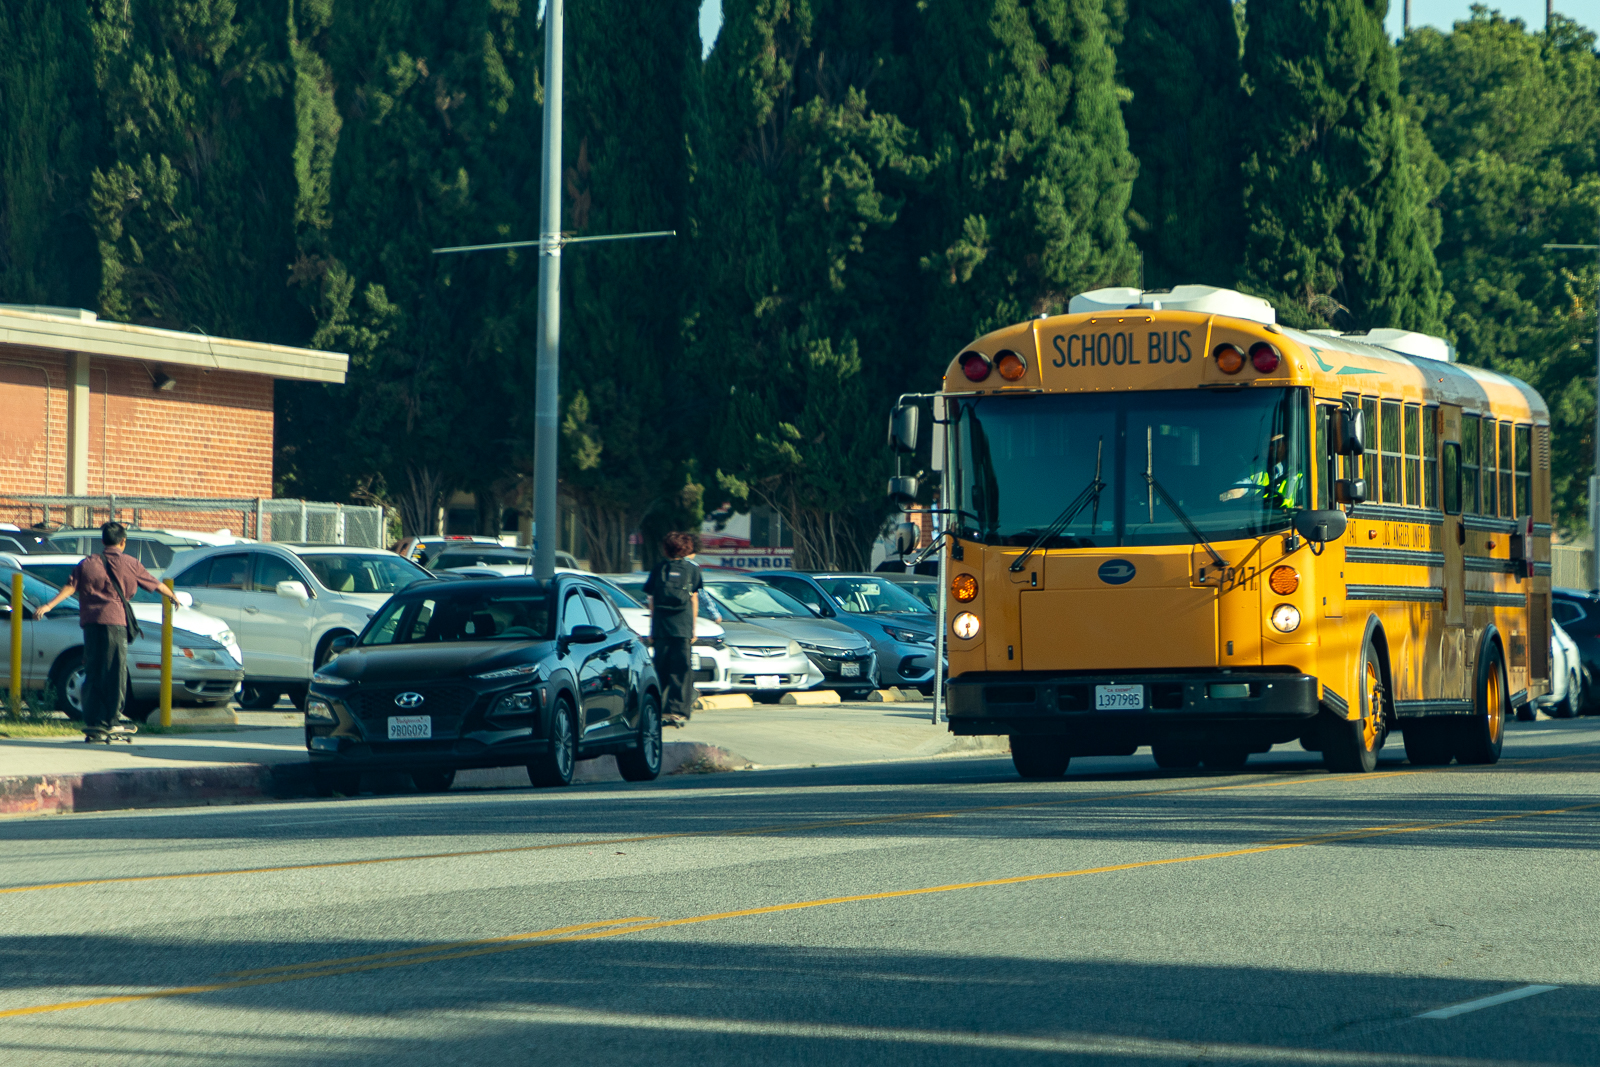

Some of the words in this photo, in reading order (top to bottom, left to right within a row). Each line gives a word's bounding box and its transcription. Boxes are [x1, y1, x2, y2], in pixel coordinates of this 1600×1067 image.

[1052, 331, 1140, 368] SCHOOL
[1147, 330, 1192, 364] BUS
[1218, 566, 1256, 592] 7947
[1098, 693, 1140, 707] 1397985
